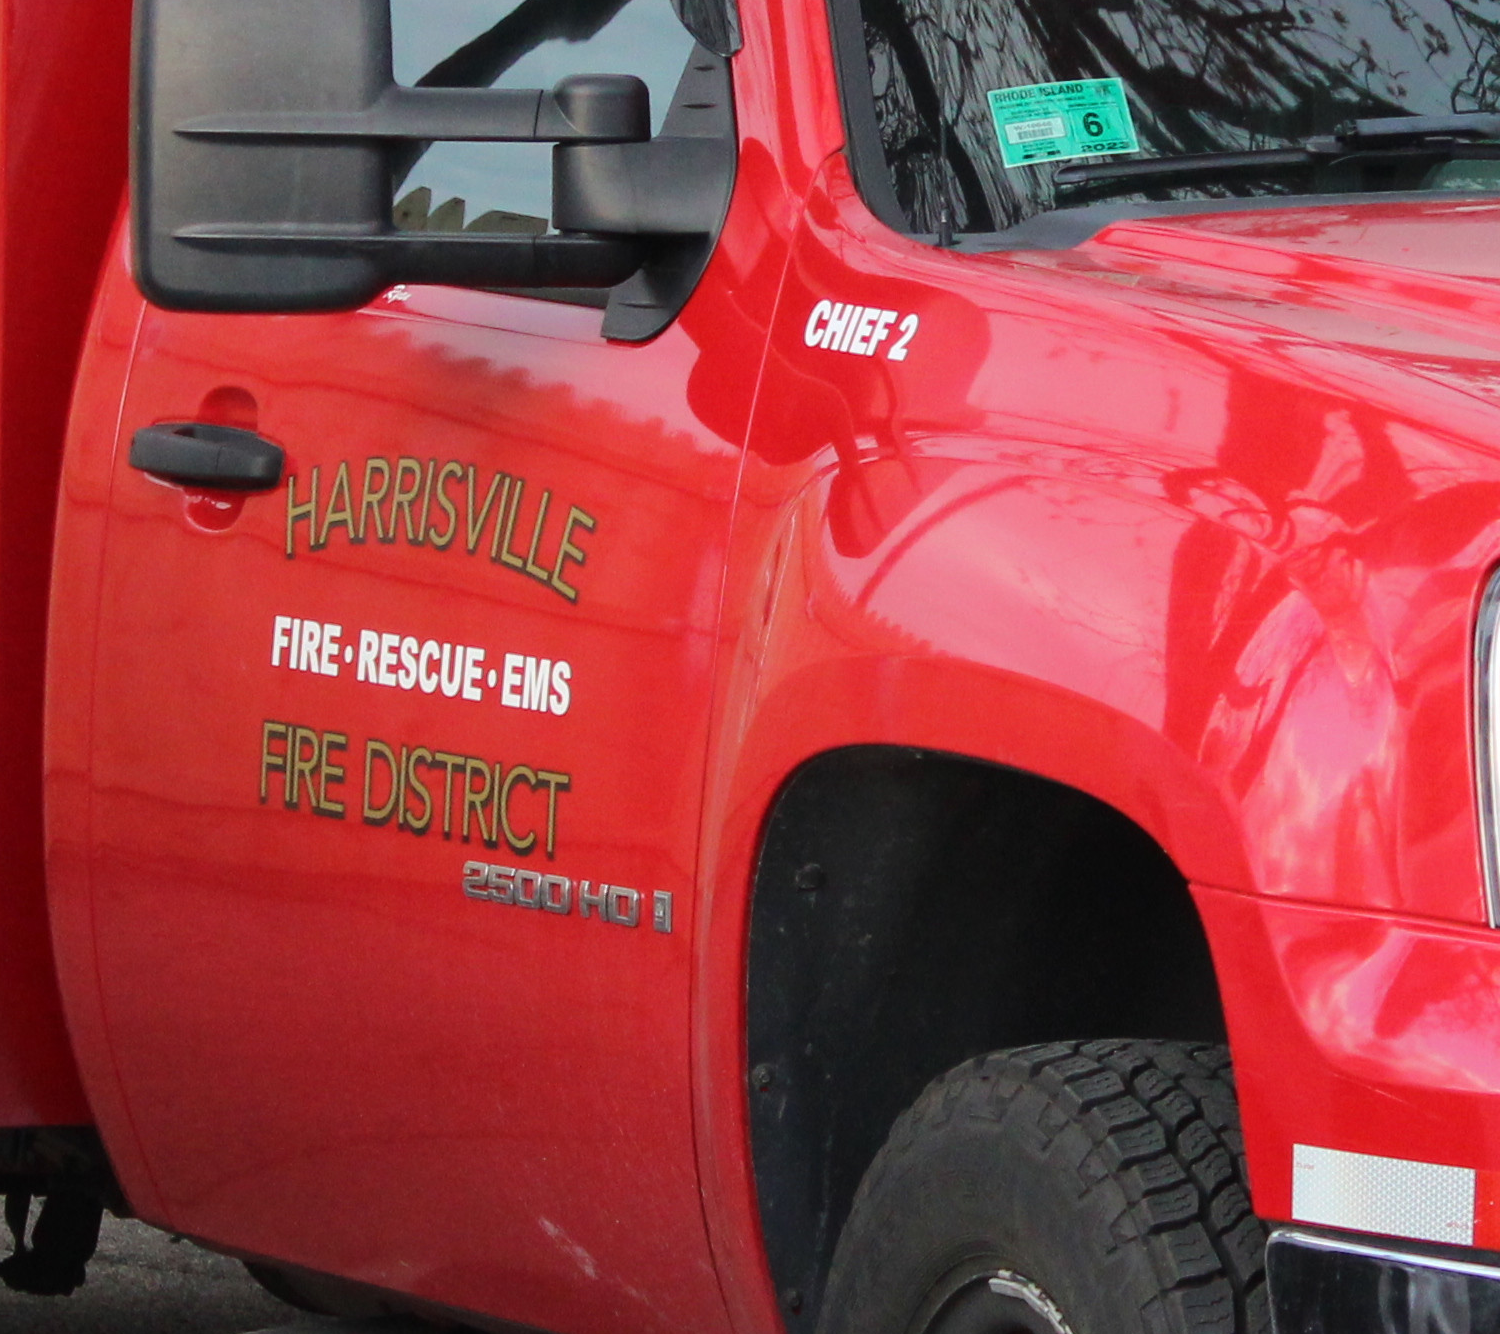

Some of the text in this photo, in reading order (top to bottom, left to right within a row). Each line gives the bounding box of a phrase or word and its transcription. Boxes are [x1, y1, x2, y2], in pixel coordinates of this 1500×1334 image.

[993, 85, 1037, 105] RHODE
[1038, 82, 1084, 99] ISLAND
[1083, 111, 1104, 137] 6
[803, 298, 921, 362] CHIEF 2
[283, 455, 597, 605] HARRISVILLE
[257, 720, 572, 858] FIRE DISTRICT
[462, 859, 573, 918] 2500
